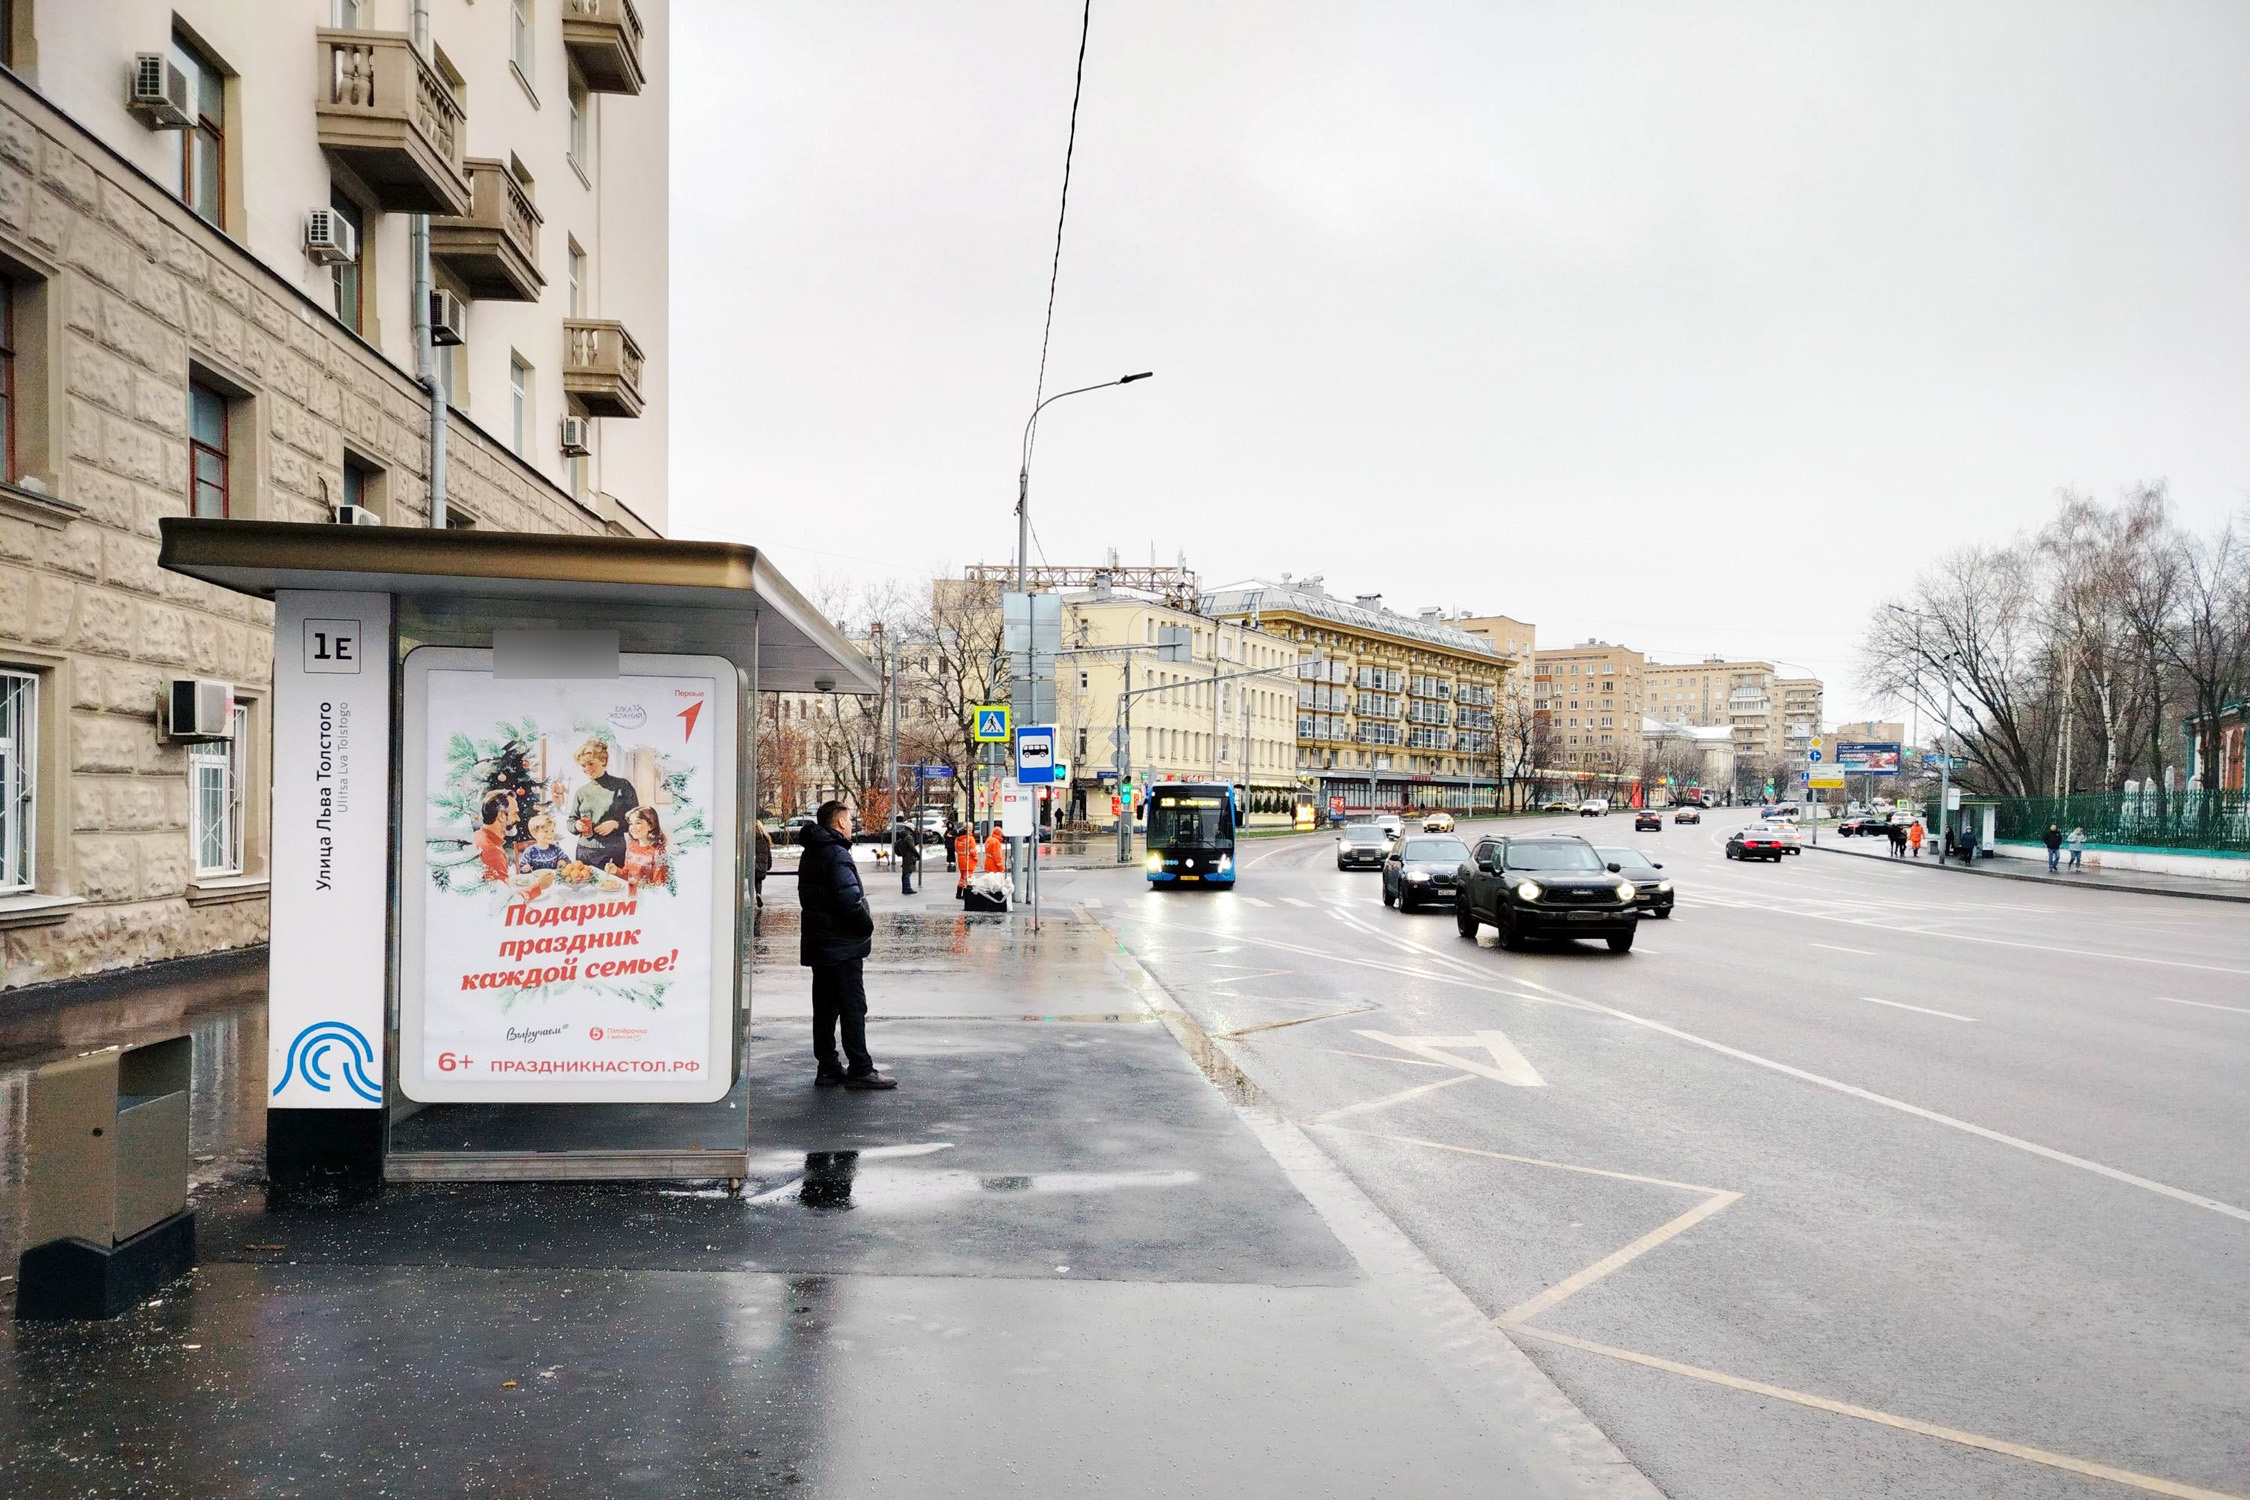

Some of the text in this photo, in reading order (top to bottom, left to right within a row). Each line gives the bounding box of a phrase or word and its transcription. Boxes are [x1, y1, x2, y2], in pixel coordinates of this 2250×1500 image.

[674, 689, 705, 698] Первые
[337, 701, 350, 814] Ulitsa Lva Tolstogo
[315, 701, 333, 891] Улица Льва Толстого
[504, 900, 637, 928] Подарим
[498, 928, 642, 961] праздник
[461, 948, 679, 991] каждой семье!
[506, 1026, 562, 1044] Выручаем
[607, 1027, 648, 1035] Пятёрочка
[437, 1052, 475, 1073] 6+
[490, 1060, 701, 1074] ПРАЗДНИКНАСТОЛ.РФ
